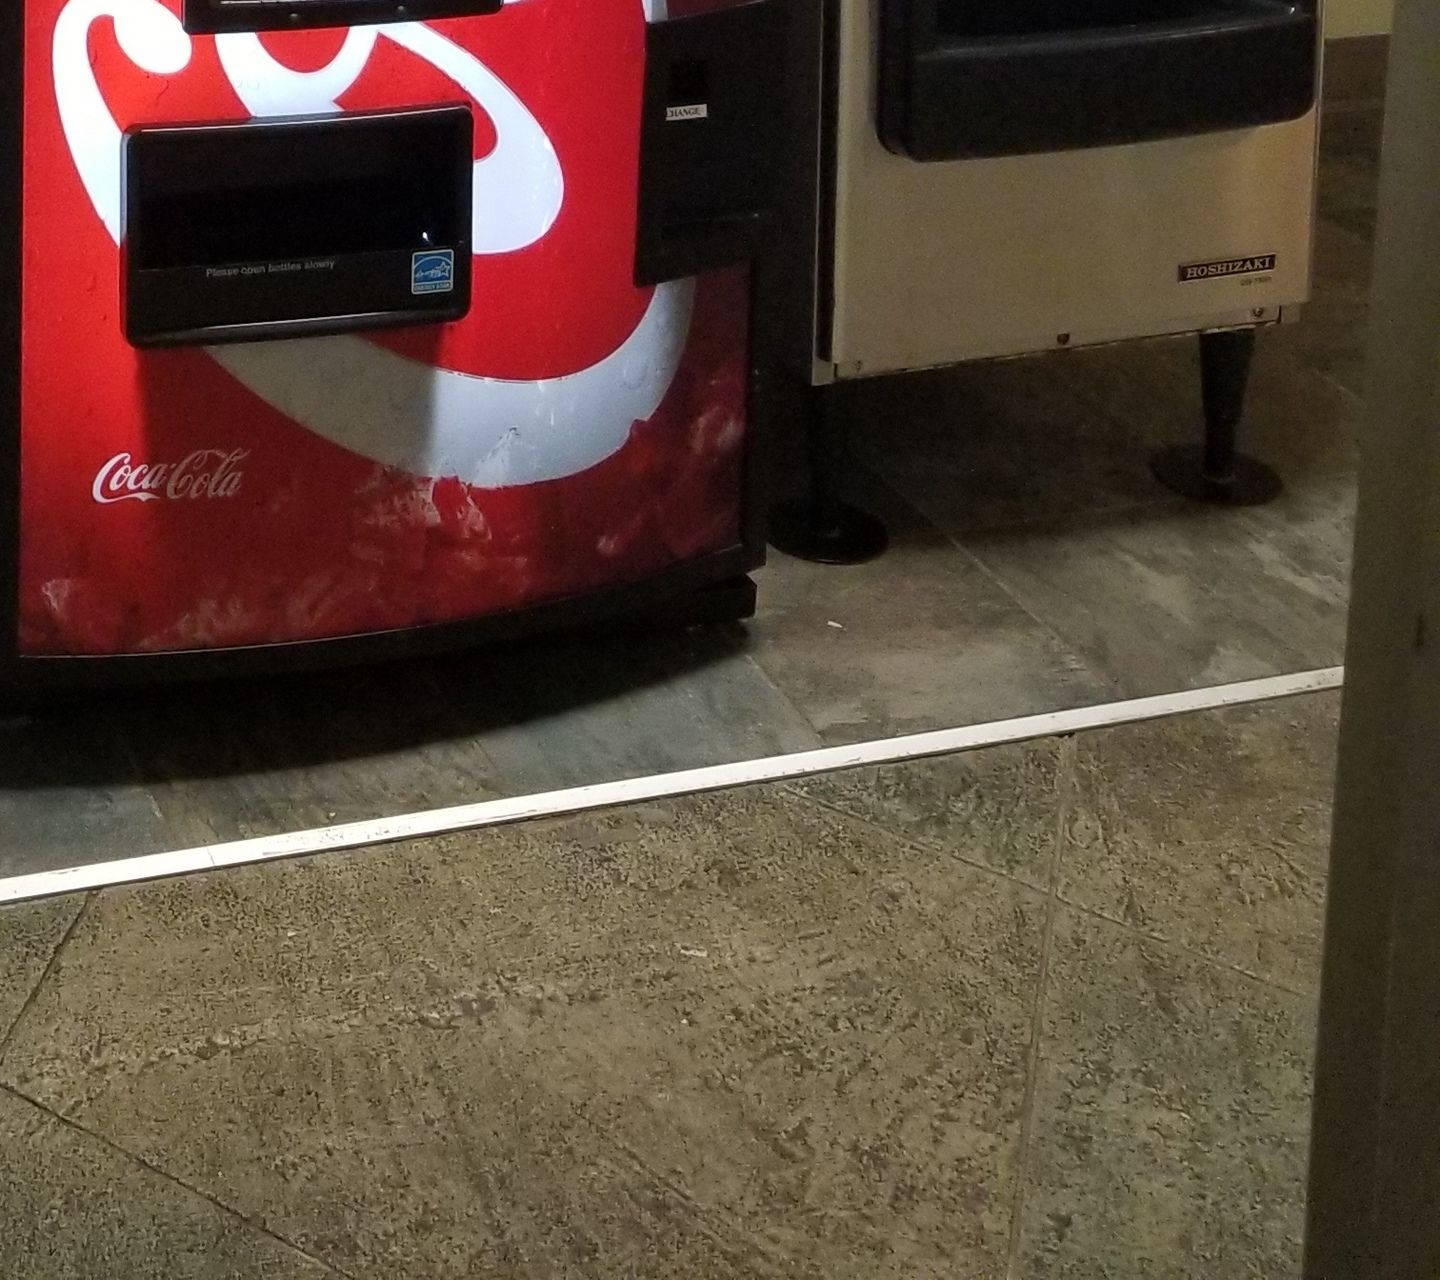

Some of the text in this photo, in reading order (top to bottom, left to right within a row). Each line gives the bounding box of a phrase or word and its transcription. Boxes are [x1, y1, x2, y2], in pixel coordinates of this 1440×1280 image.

[268, 263, 301, 273] bottles
[305, 259, 335, 270] slowly
[1185, 257, 1271, 279] HOSHIZAKI
[92, 447, 251, 504] Coca-Cola
